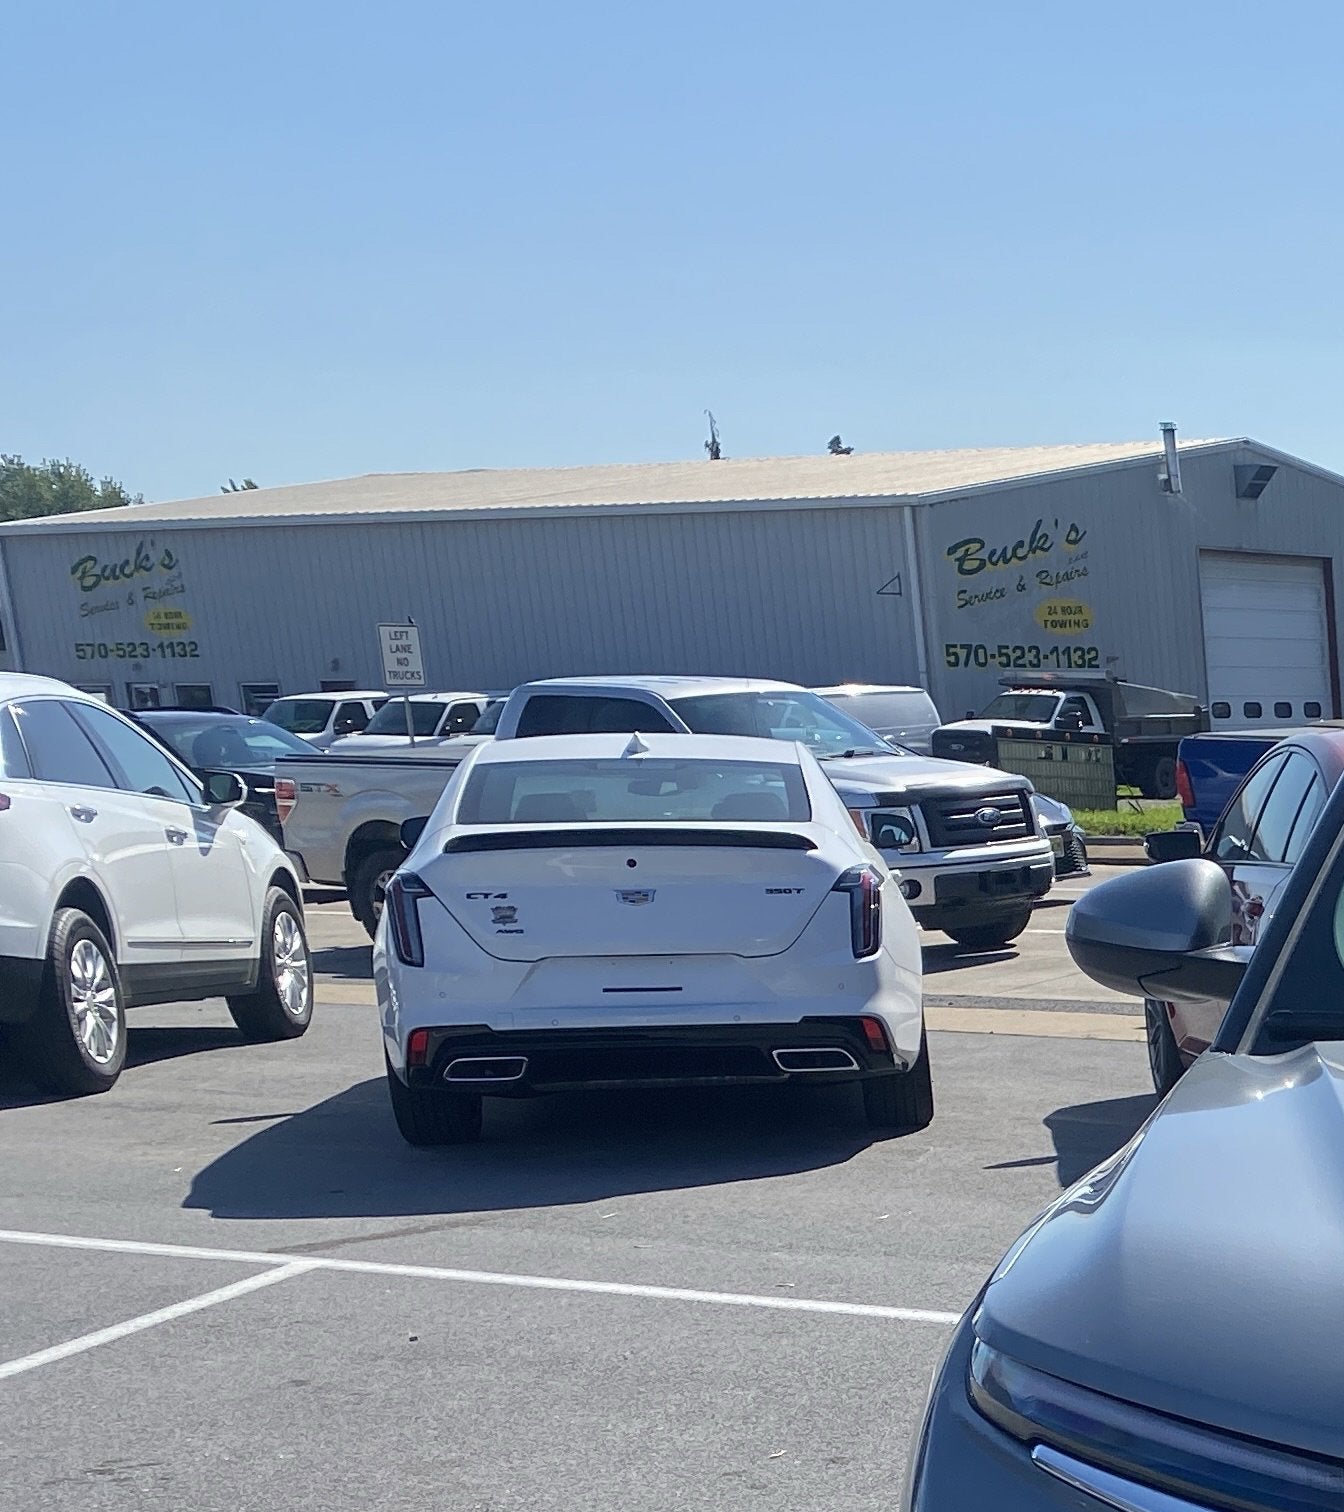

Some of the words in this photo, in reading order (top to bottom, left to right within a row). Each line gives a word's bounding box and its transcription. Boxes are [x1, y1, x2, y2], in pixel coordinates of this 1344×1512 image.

[947, 518, 1087, 576] Buck's
[70, 539, 179, 592] Buck's
[957, 587, 1007, 609] Service
[1016, 575, 1026, 592] &
[1036, 567, 1089, 591] Repairs
[1043, 619, 1089, 629] TOWING
[389, 630, 409, 640] LEFT
[75, 641, 200, 660] 570-523-1132
[389, 644, 413, 654] LANE
[945, 643, 1100, 669] 570-523-1132
[396, 657, 409, 667] NO
[387, 670, 422, 681] TRUCKS
[465, 892, 508, 900] CT4
